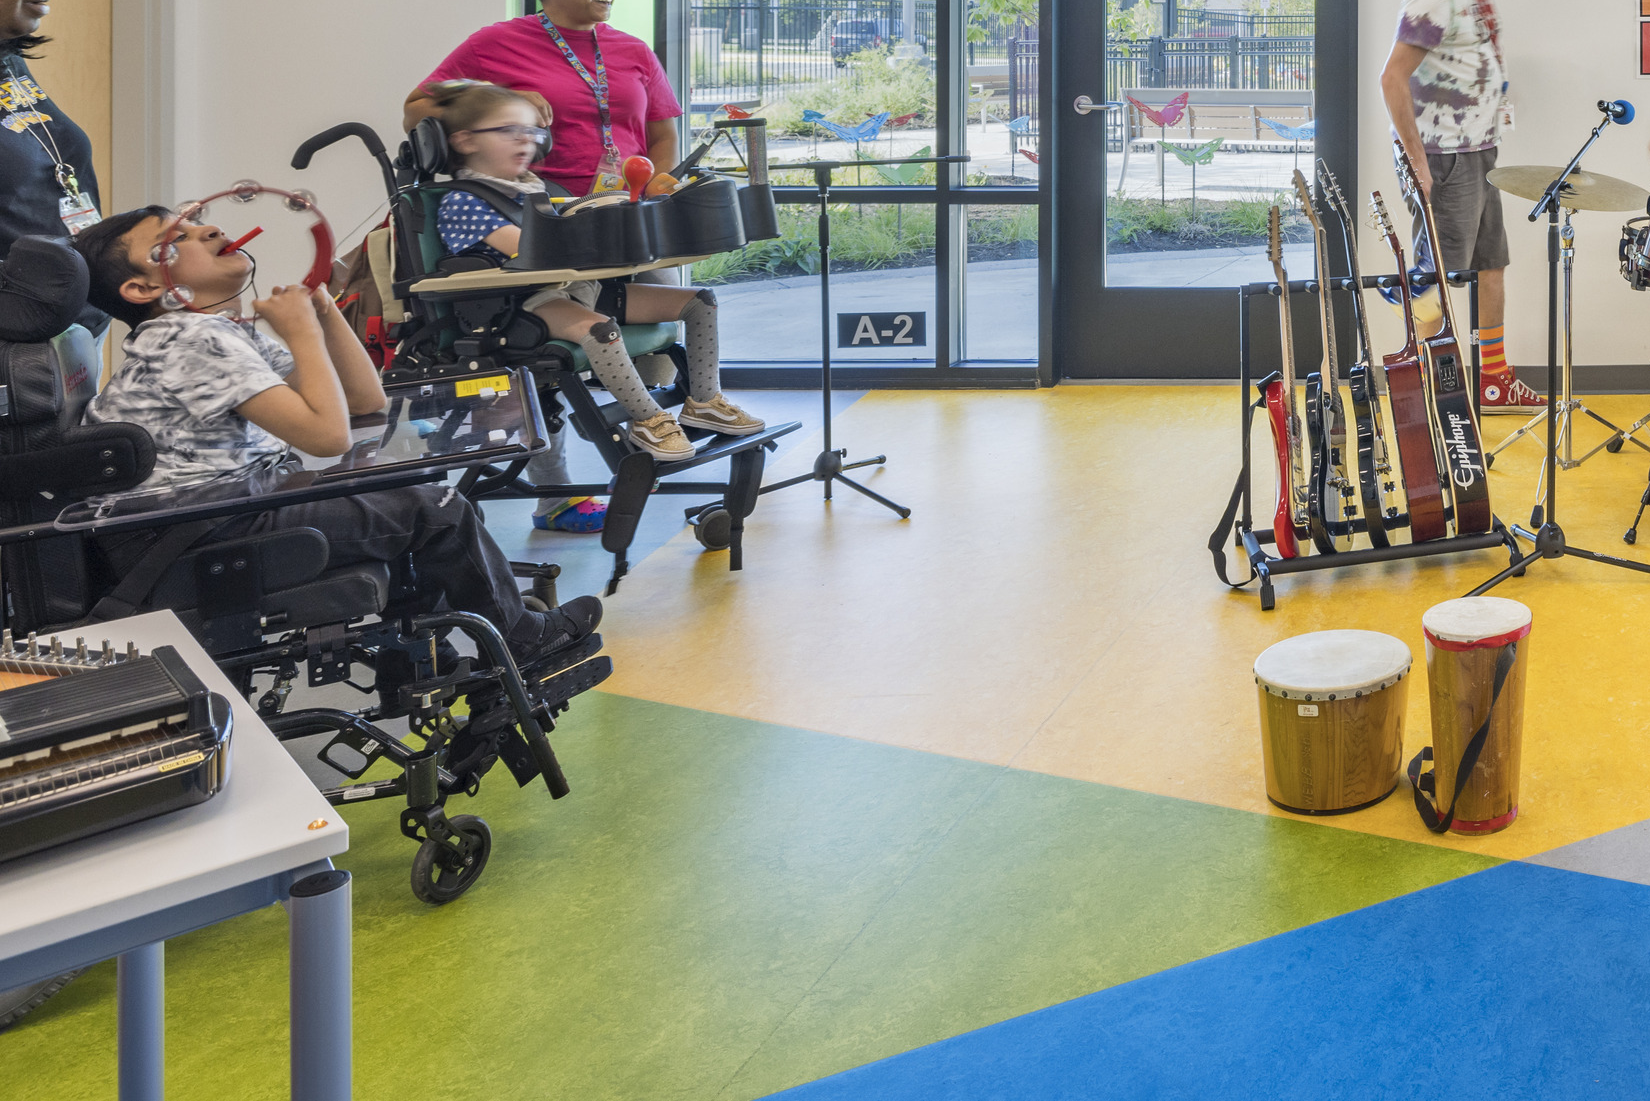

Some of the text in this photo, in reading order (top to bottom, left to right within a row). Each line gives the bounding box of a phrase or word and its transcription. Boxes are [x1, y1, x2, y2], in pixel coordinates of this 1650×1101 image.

[851, 314, 914, 345] A-2
[1445, 412, 1485, 491] Epiphone
[540, 632, 570, 656] PUMA
